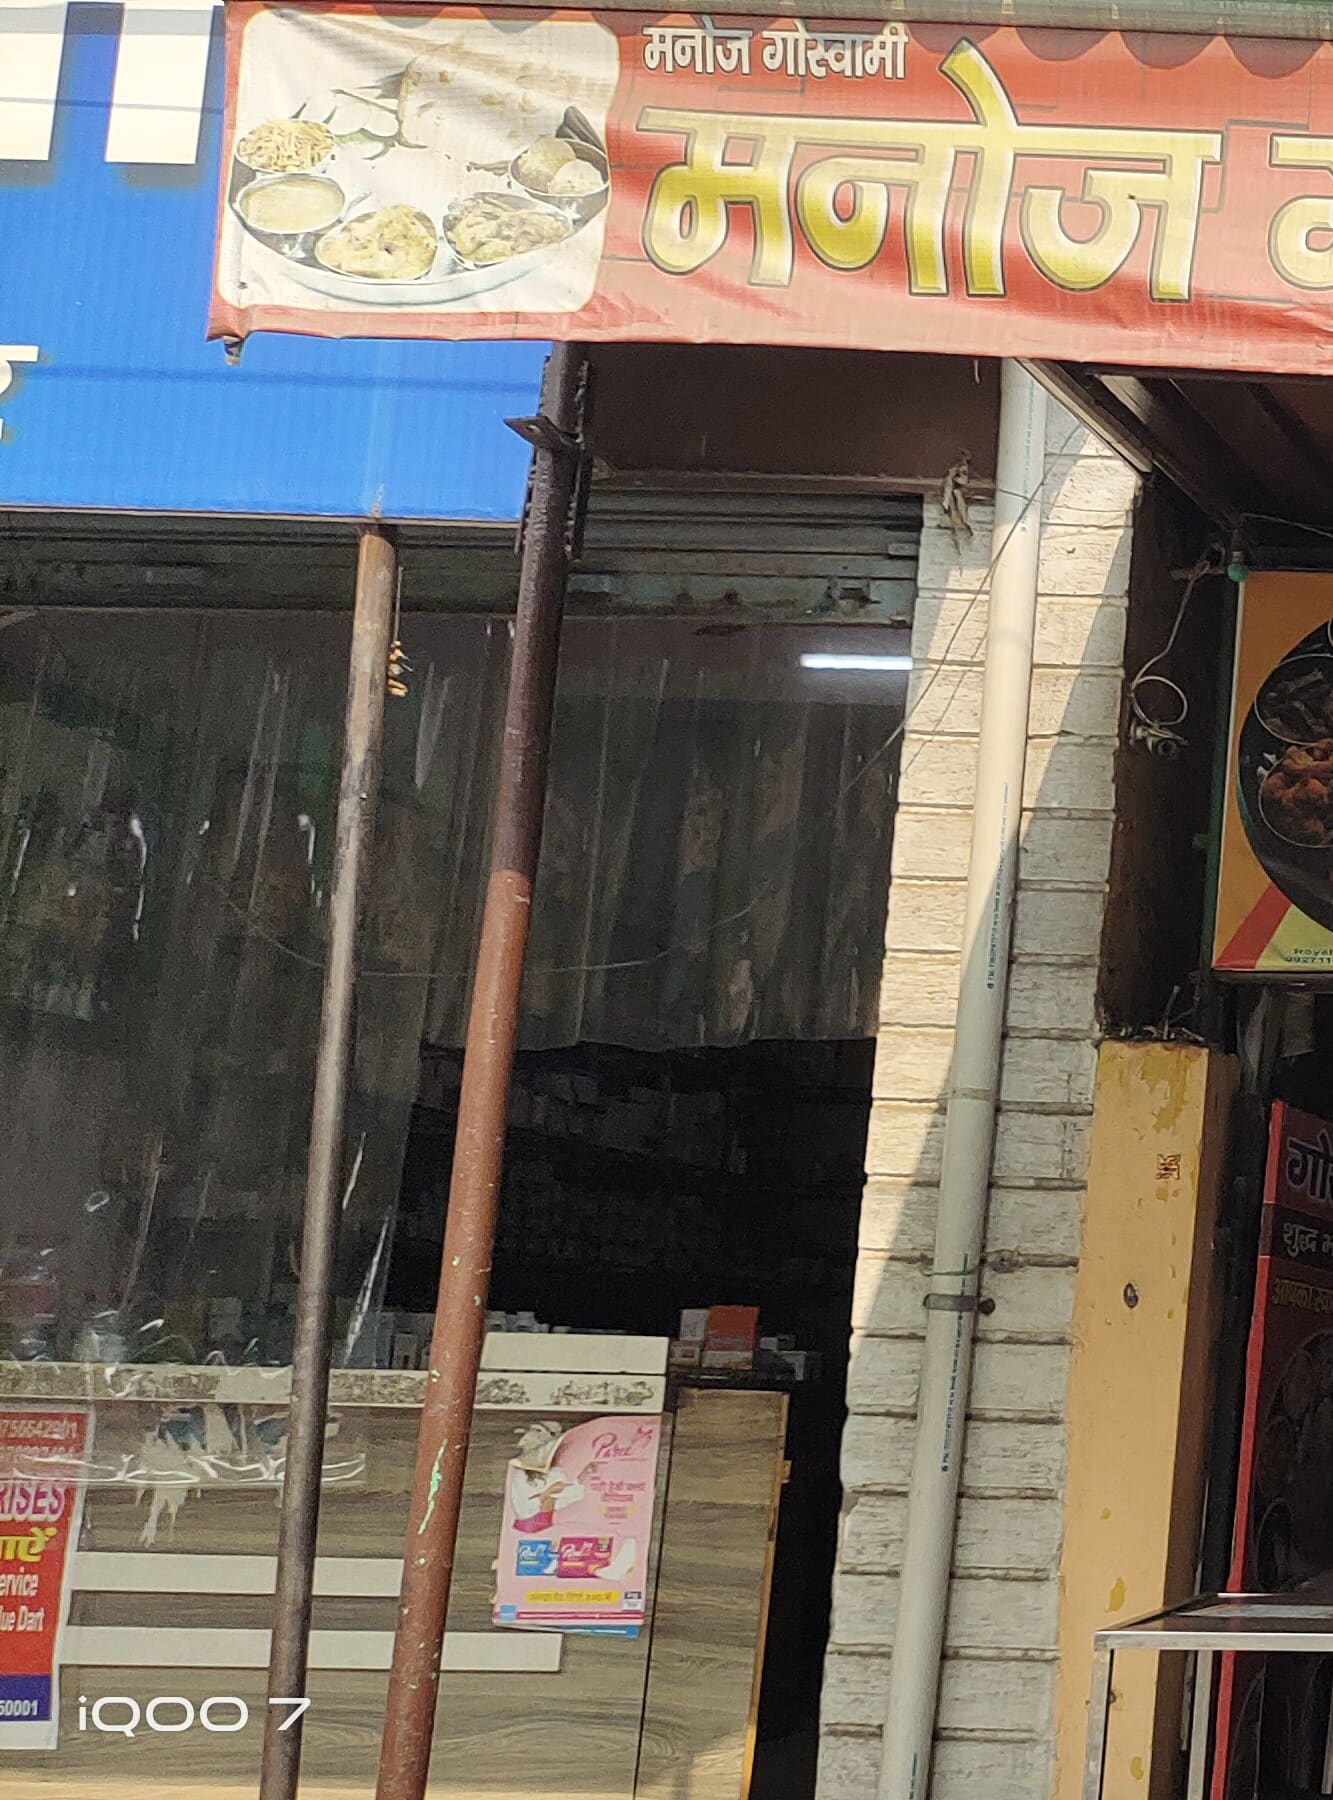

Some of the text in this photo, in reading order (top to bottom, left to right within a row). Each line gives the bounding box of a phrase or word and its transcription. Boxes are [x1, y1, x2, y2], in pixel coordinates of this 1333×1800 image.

[642, 15, 909, 80] मनोज गोस्वामी
[636, 38, 1225, 303] मनोज
[1282, 1221, 1317, 1257] शुद्ध
